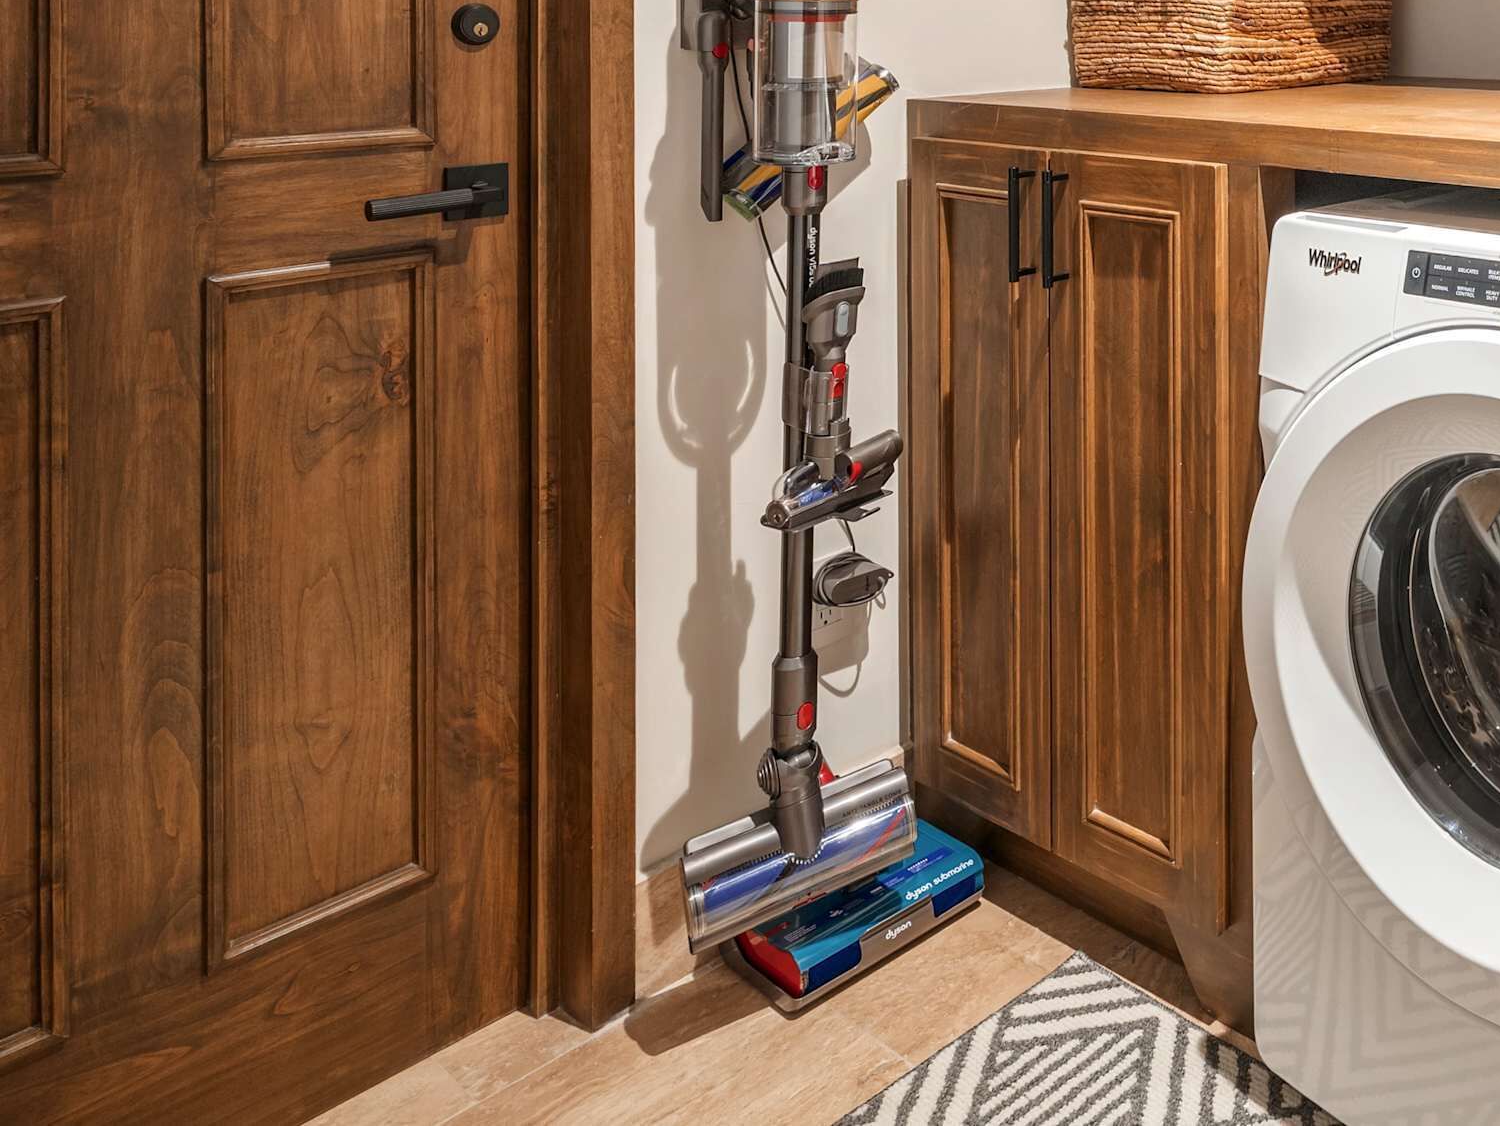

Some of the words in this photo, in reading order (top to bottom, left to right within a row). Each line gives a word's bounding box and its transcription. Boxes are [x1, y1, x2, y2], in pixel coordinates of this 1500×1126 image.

[807, 226, 818, 255] dyson
[1308, 248, 1362, 275] Whirlpool
[905, 882, 933, 902] dyson
[933, 858, 974, 885] submarine
[884, 920, 912, 940] dyson
